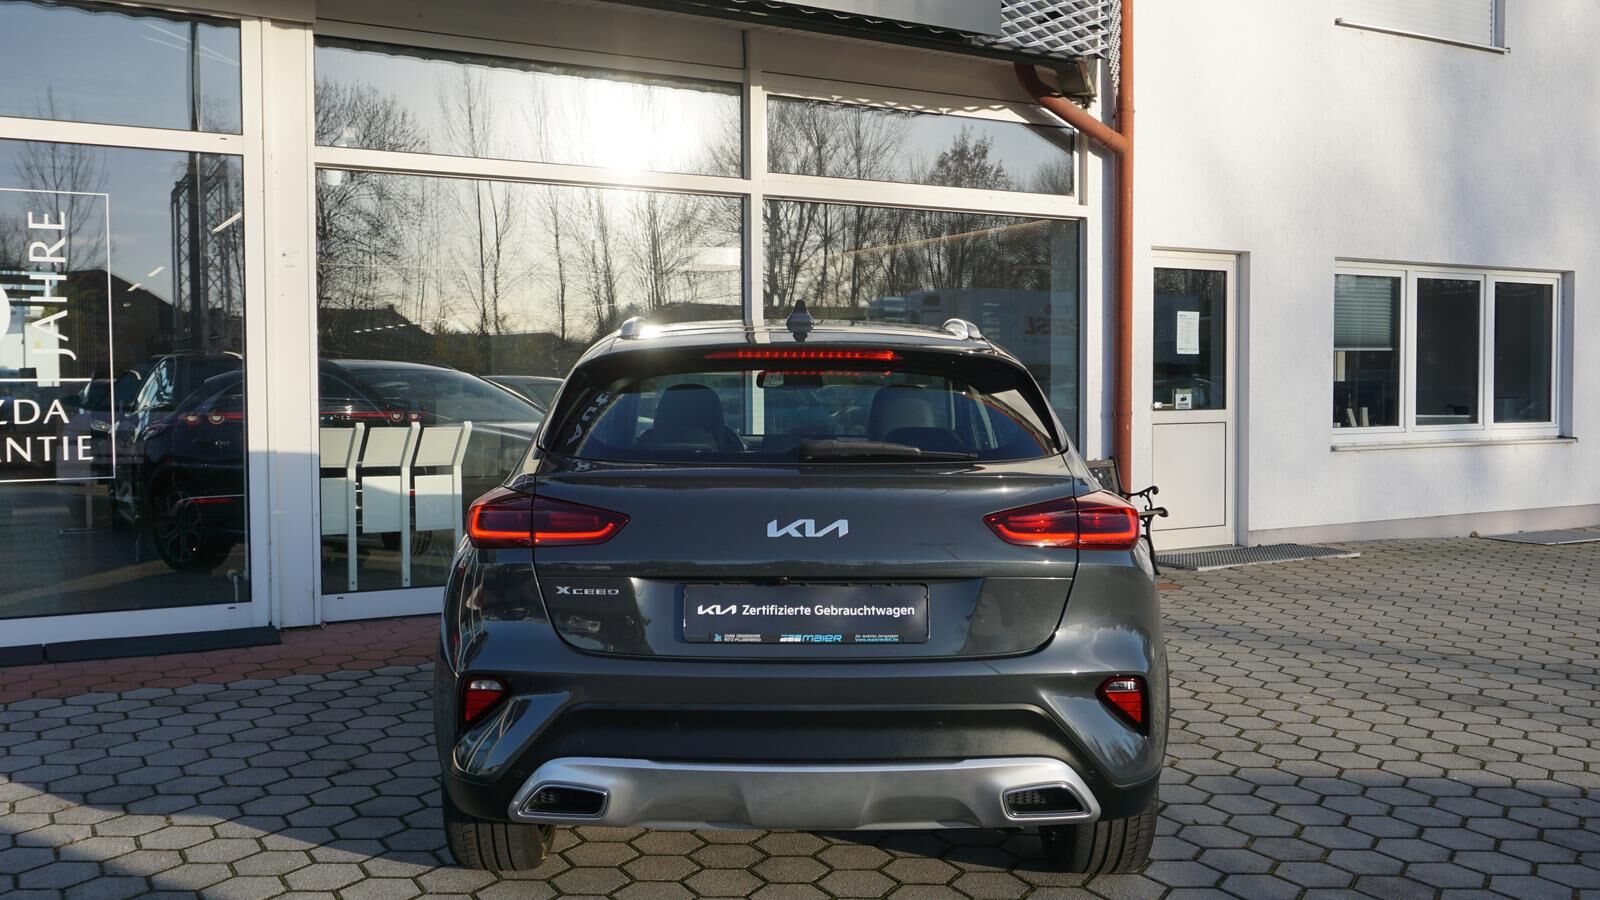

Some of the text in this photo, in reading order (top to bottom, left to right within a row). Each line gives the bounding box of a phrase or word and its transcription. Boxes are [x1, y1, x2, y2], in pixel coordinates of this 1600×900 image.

[28, 211, 77, 361] JAHRE
[0, 435, 94, 463] NTIE
[766, 518, 849, 538] KIA
[697, 604, 915, 618] KIA Zertifizierte Gebrauchtwagen
